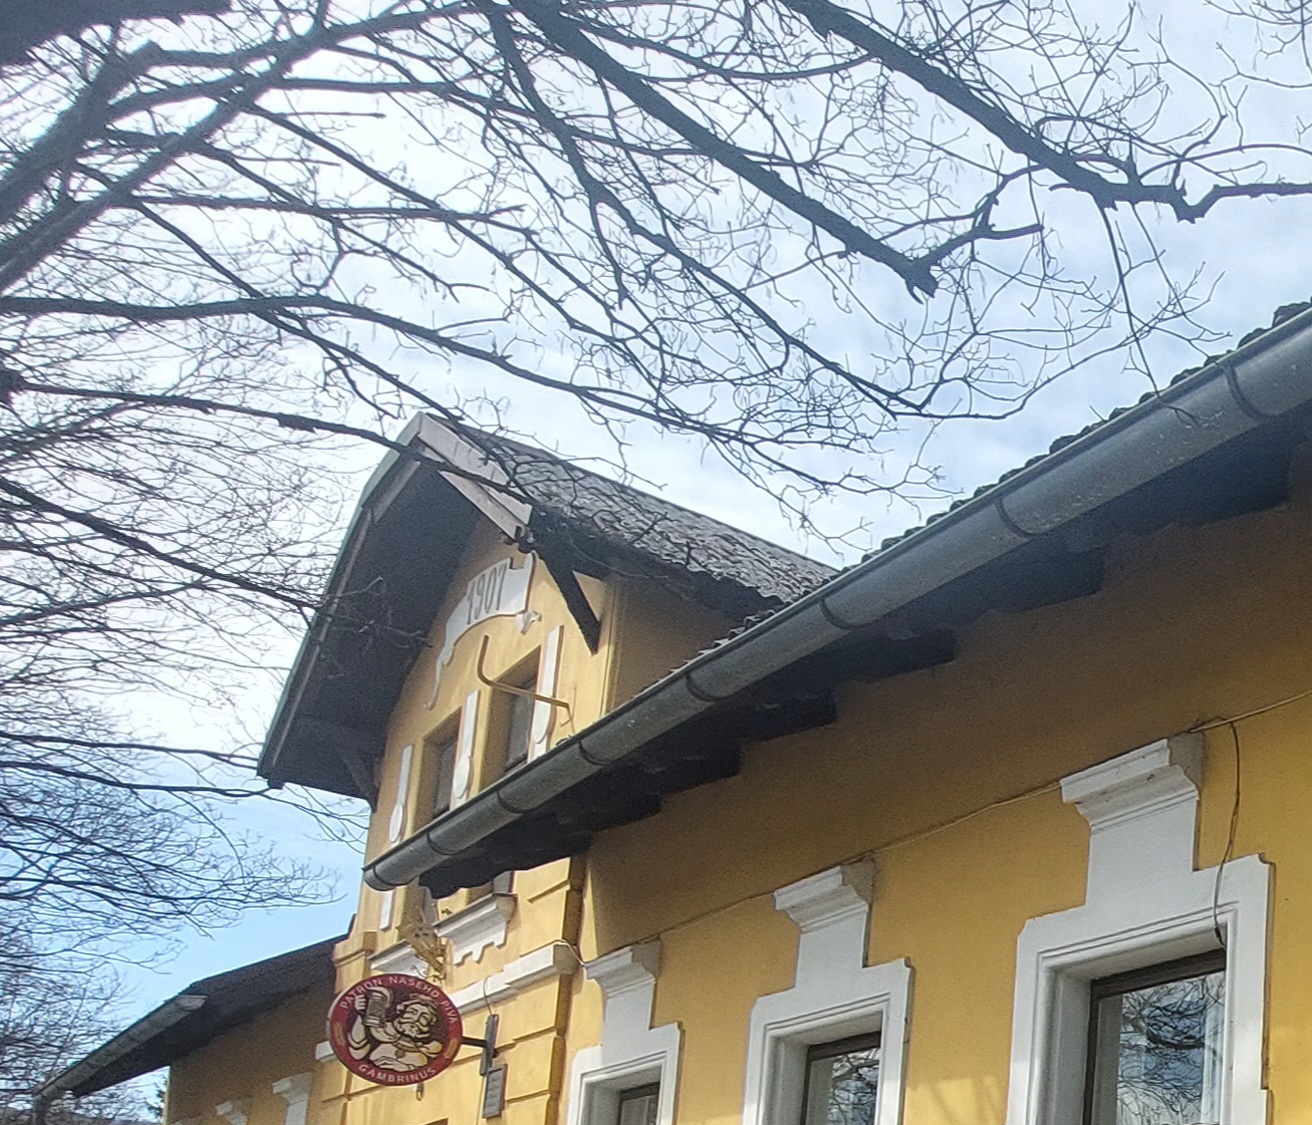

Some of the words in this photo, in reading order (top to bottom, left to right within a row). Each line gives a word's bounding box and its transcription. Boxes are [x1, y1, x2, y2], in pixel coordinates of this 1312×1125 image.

[467, 562, 508, 625] 1907
[340, 978, 383, 1009] PATRON
[439, 998, 458, 1024] PIVA
[358, 1063, 437, 1084] GAMBRINUS
